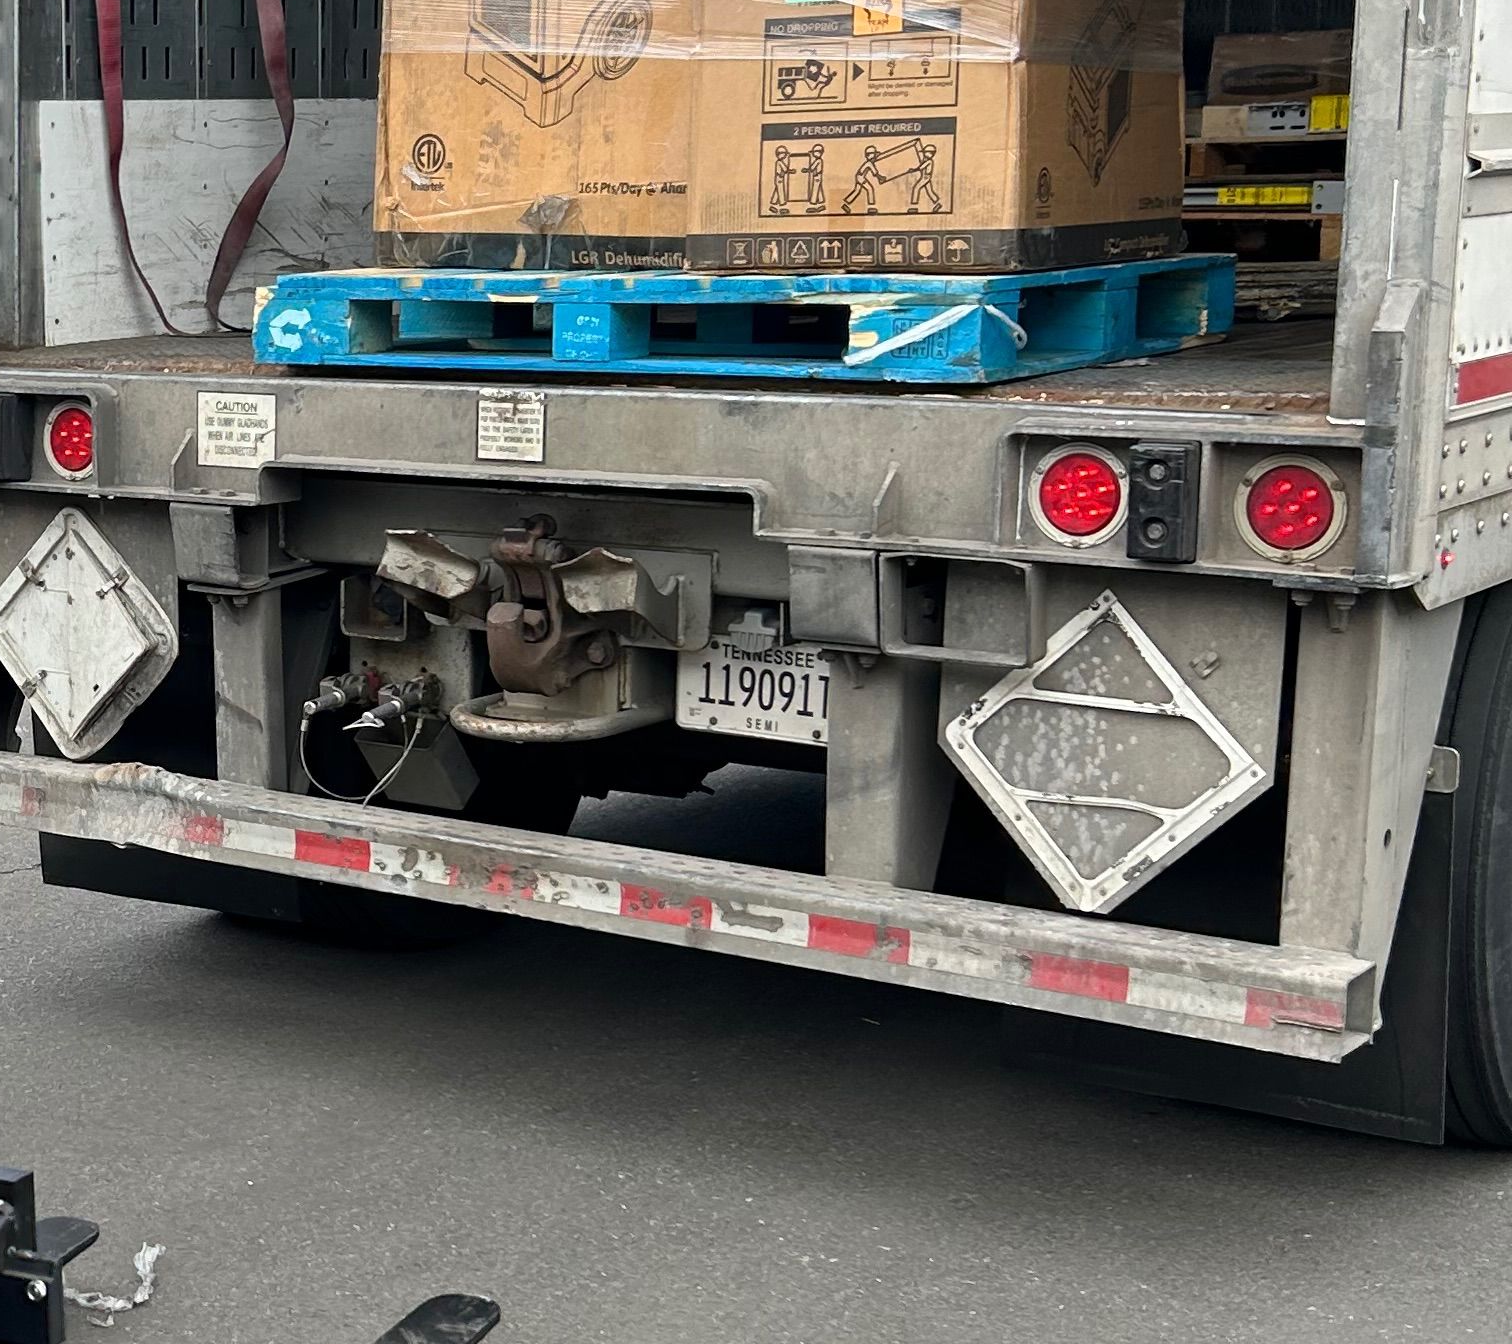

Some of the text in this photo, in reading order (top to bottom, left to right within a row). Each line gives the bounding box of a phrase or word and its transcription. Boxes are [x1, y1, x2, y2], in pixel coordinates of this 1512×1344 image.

[770, 21, 839, 34] NO DROPPING
[793, 123, 921, 136] 2 PERSON LIFT REQUIRED
[579, 182, 599, 194] 165
[572, 250, 688, 268] LGR Dehumidifi
[216, 401, 257, 412] CAUTION
[722, 643, 815, 669] TENNESSEE
[746, 717, 779, 732] SEMI
